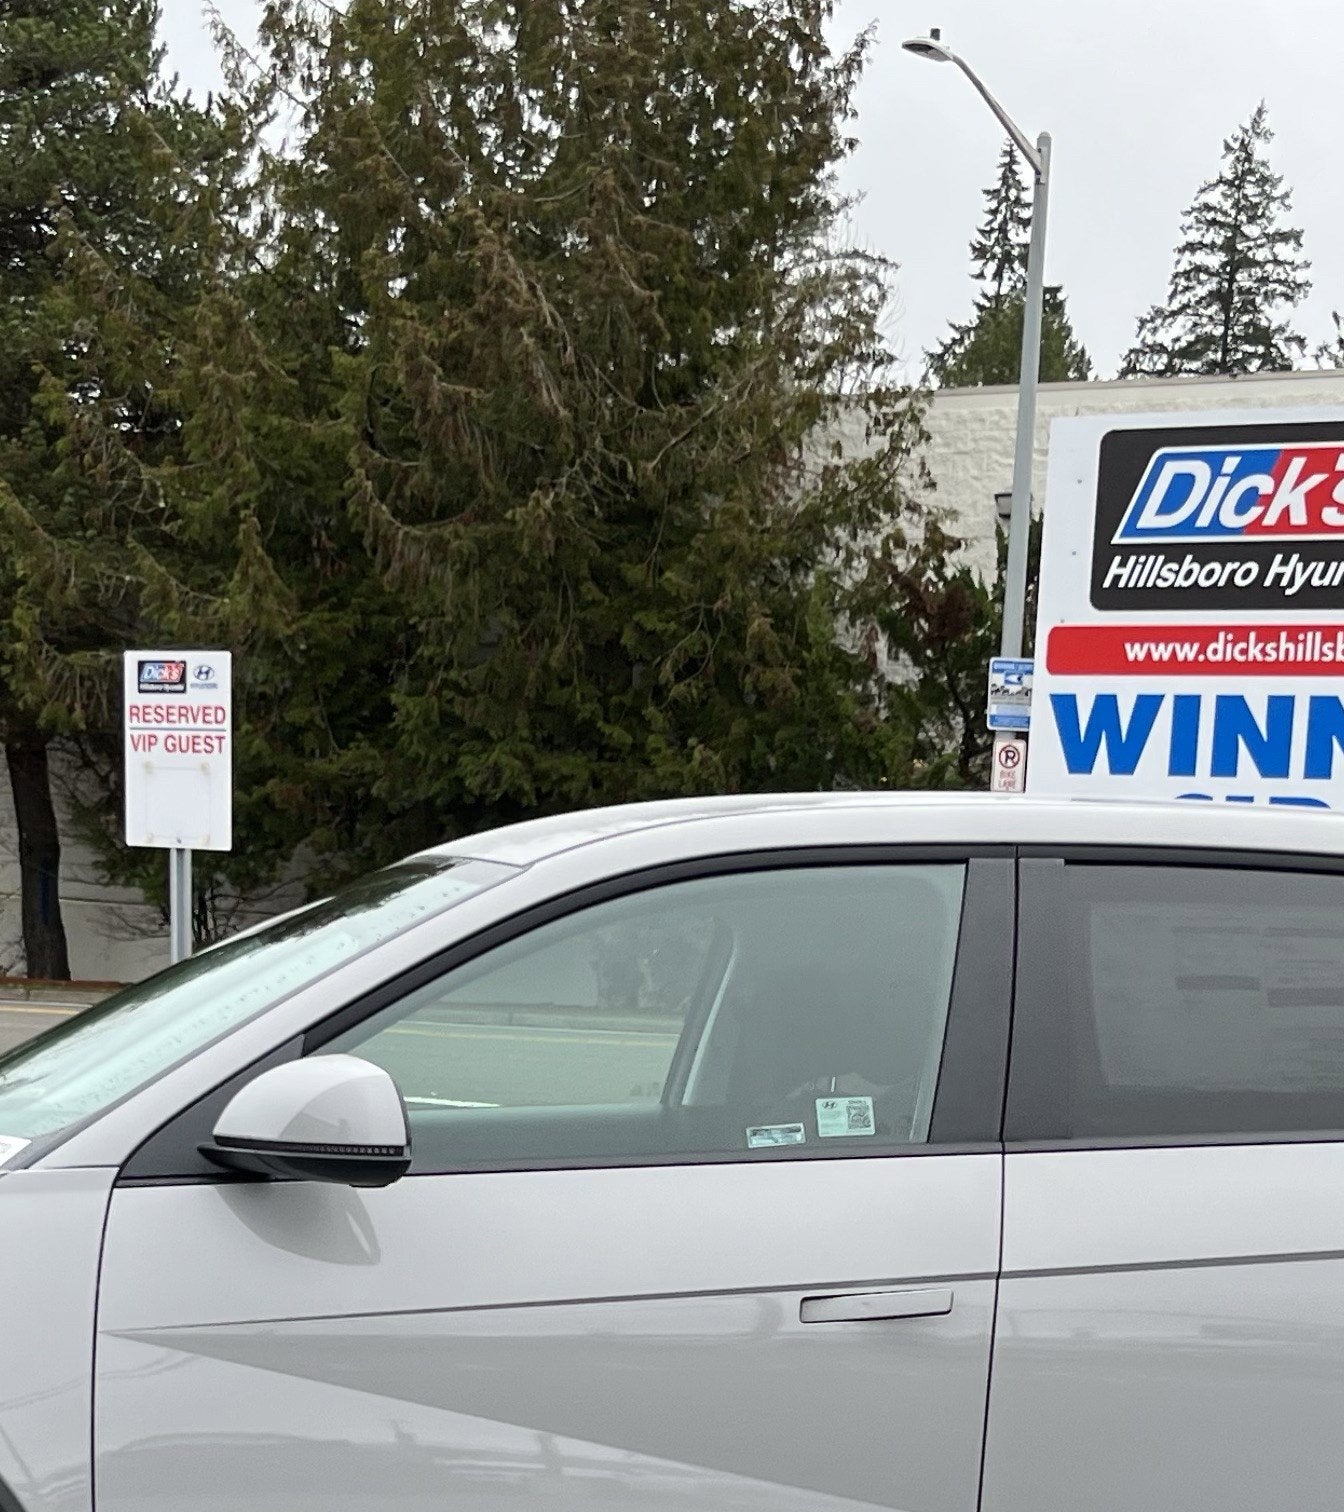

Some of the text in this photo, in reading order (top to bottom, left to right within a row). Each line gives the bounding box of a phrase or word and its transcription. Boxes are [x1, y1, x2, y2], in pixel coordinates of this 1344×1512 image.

[1102, 554, 1259, 588] Hillsboro
[129, 704, 226, 725] RESERVED
[130, 733, 226, 754] VIP GUEST
